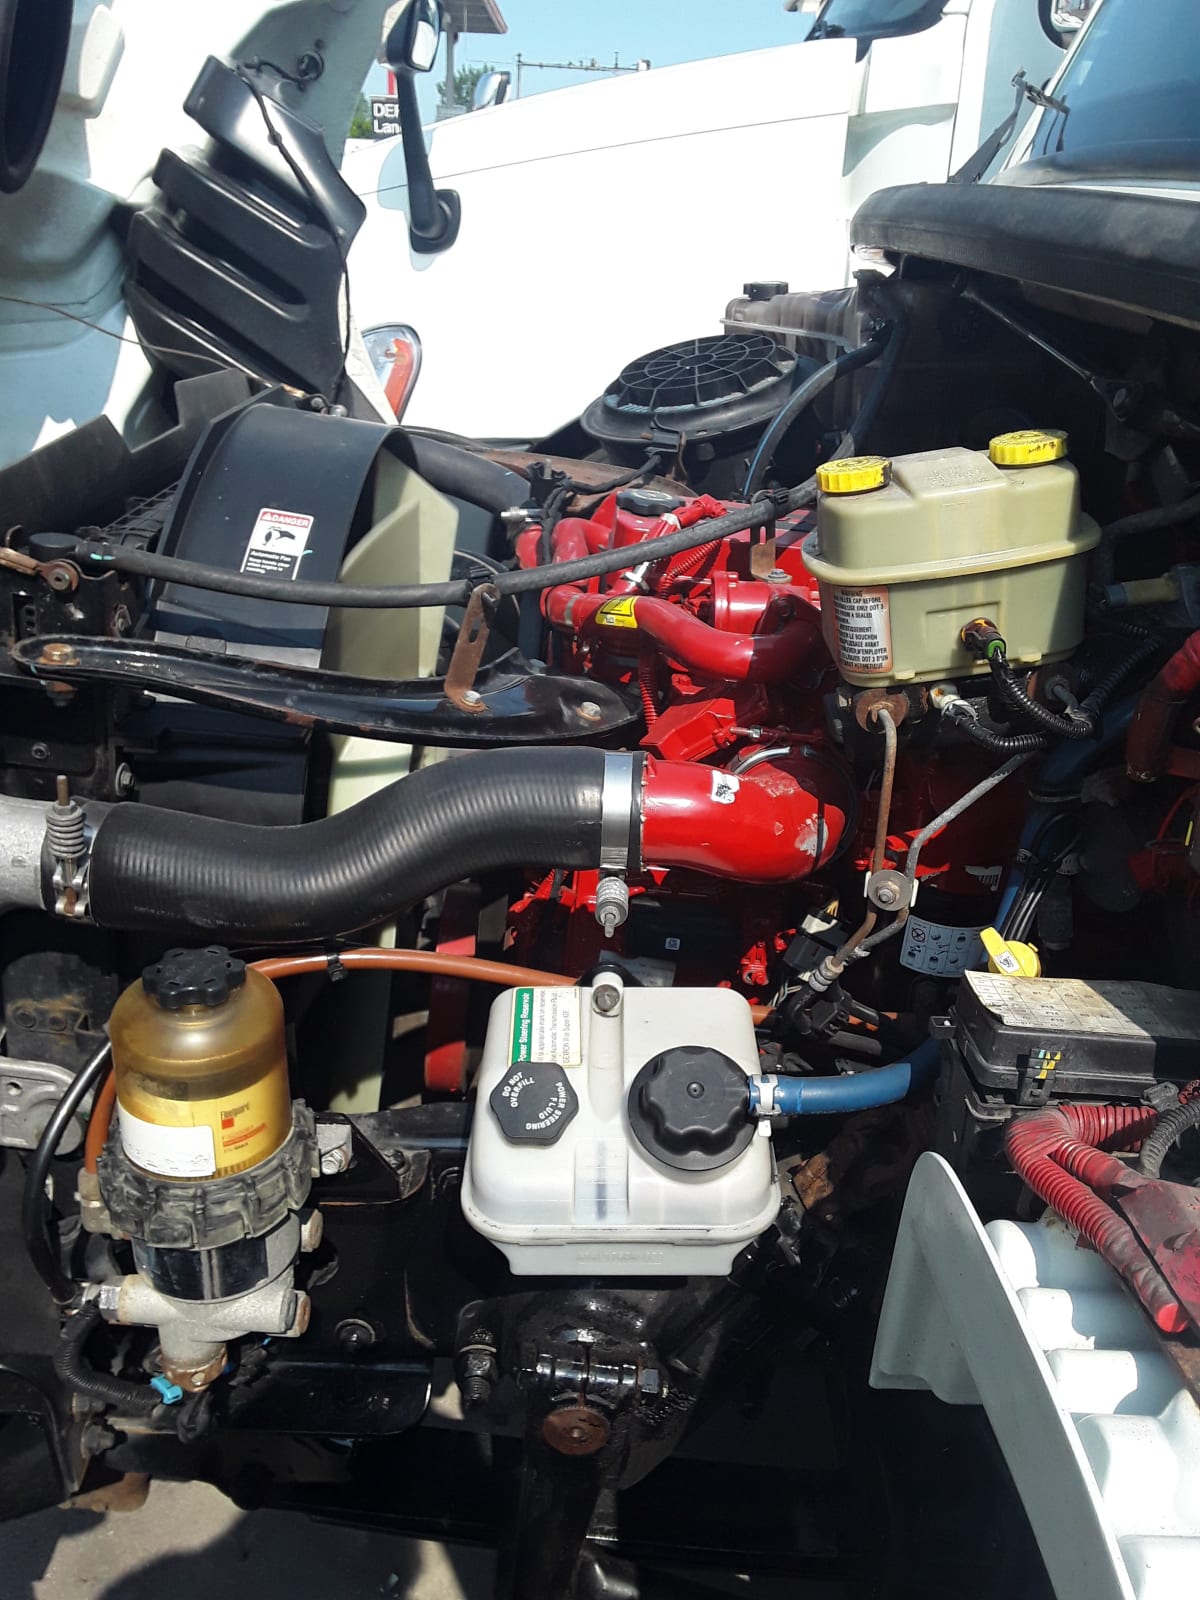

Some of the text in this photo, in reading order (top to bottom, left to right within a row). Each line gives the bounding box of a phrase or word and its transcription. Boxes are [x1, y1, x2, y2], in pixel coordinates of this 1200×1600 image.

[374, 120, 400, 134] Lan
[272, 514, 309, 528] DANGER
[250, 550, 280, 560] Automatic
[518, 992, 530, 1061] Power Steering Reservoir
[502, 1072, 522, 1096] DO NOT
[510, 1077, 535, 1108] OVERFILL
[526, 1082, 566, 1130] POWER STEERING
[538, 1097, 558, 1120] FLUID
